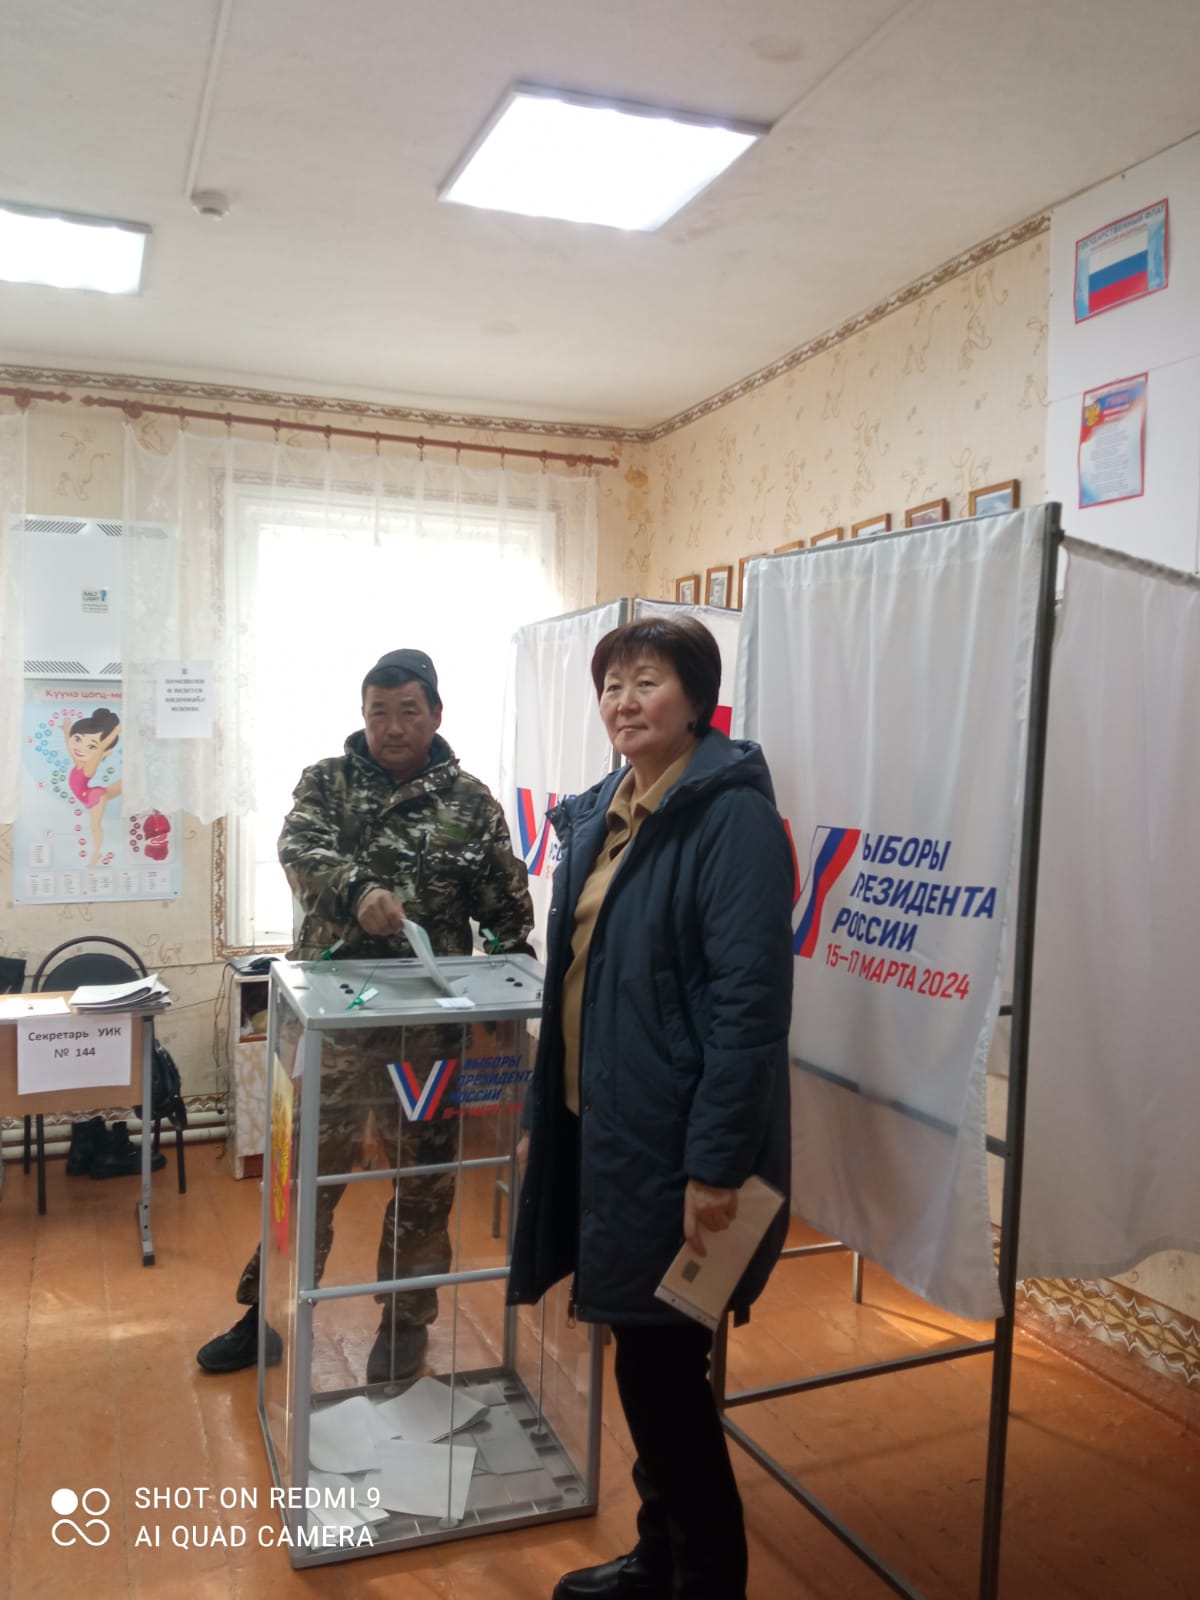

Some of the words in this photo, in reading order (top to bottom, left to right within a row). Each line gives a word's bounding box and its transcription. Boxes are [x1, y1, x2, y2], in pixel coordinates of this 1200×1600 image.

[861, 833, 952, 871] ЫБОРЫ
[832, 907, 918, 952] РОССИИ
[859, 953, 918, 991] МАРТА
[918, 968, 970, 1001] 2024
[28, 1031, 89, 1042] Секретарь
[98, 1027, 122, 1037] УИК
[54, 1048, 69, 1058] №
[75, 1047, 96, 1057] 144
